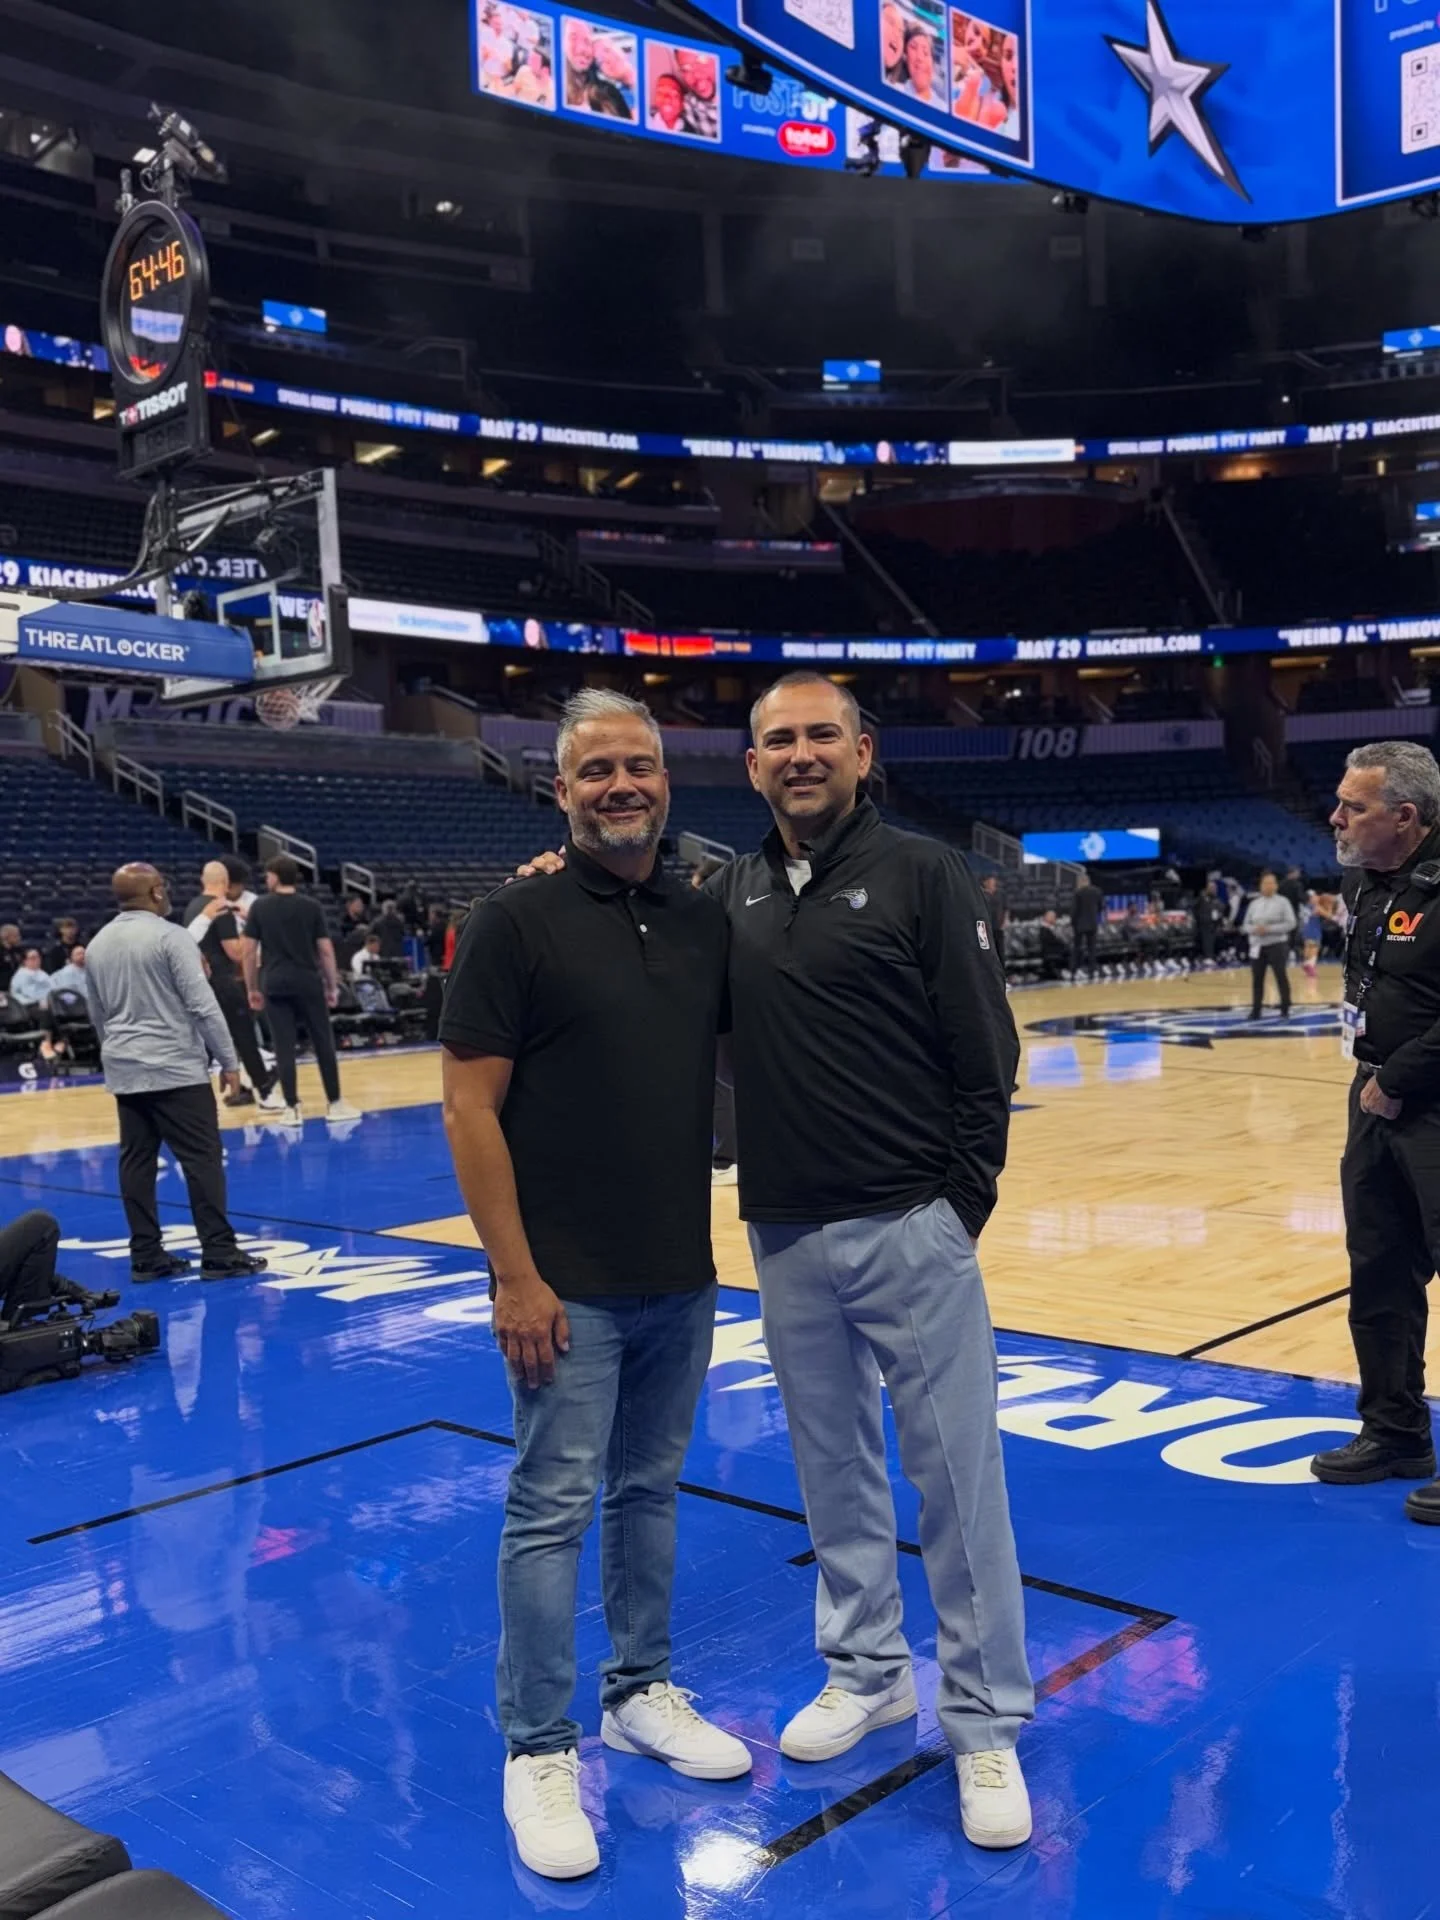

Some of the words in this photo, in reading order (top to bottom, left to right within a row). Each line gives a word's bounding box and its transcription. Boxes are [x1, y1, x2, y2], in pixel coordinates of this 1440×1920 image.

[129, 240, 185, 301] 64:46
[137, 381, 188, 420] TISSOT
[480, 418, 515, 438] MAY
[516, 421, 538, 442] 29
[1308, 424, 1344, 443] MAY
[1345, 421, 1368, 440] 29
[25, 628, 185, 662] THREATLOCKER
[1017, 639, 1056, 660] MAY
[1057, 638, 1082, 659] 29
[1086, 635, 1202, 656] KIACENTER.COM
[1278, 626, 1343, 647] "WEIRD
[1019, 728, 1078, 759] 108
